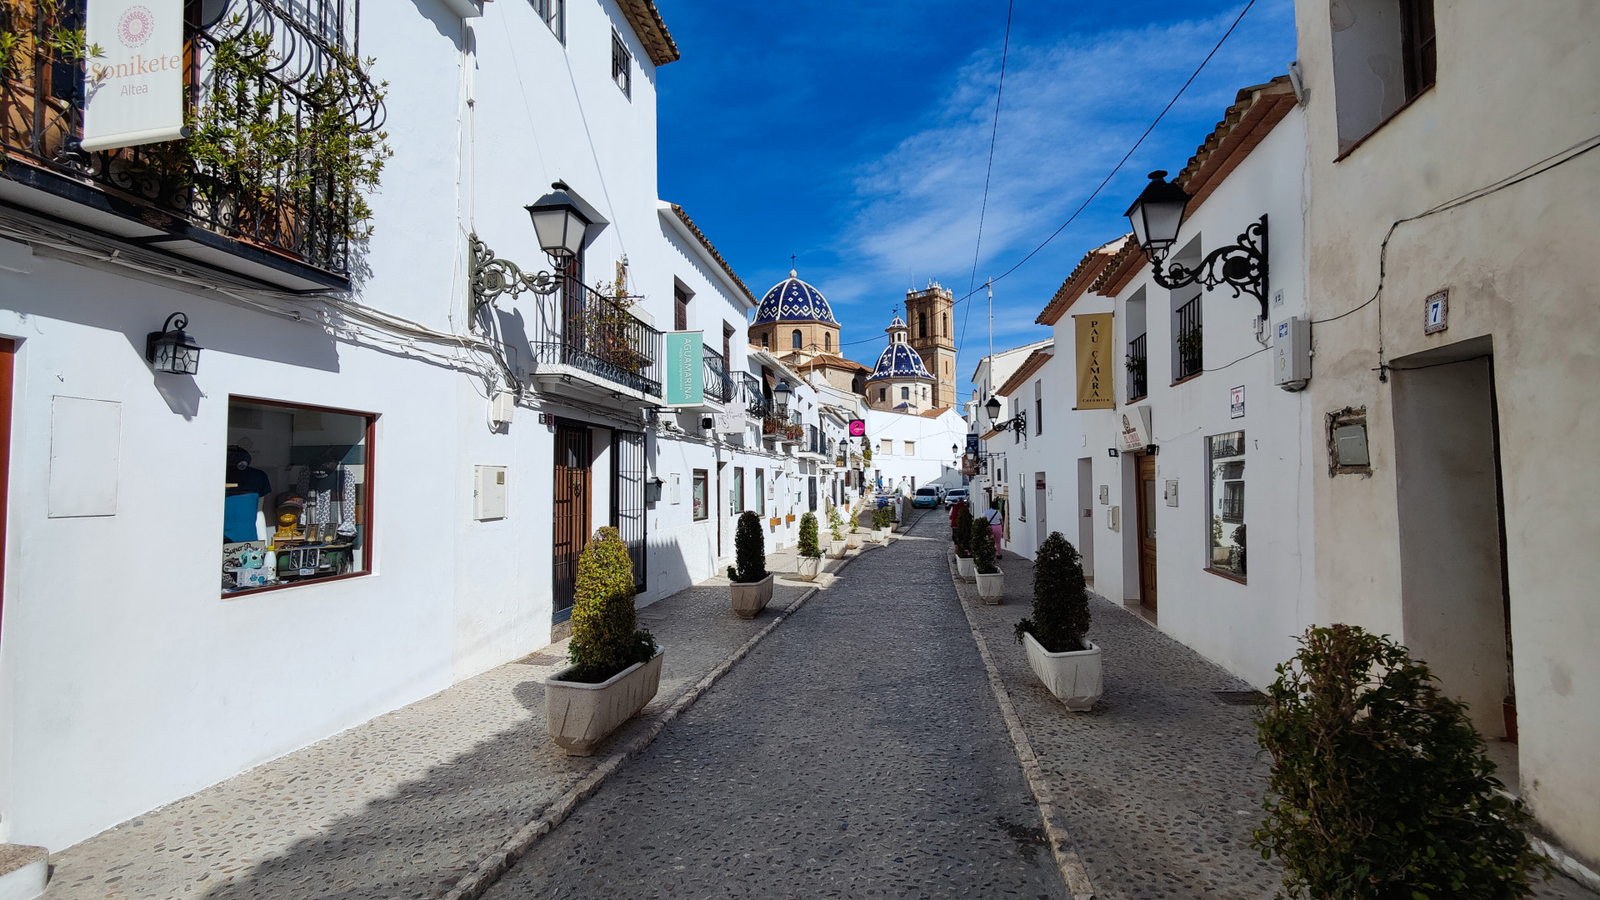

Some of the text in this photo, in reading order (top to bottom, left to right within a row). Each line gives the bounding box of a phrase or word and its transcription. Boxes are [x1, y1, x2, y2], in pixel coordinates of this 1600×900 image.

[91, 54, 181, 82] Sonikete
[120, 84, 149, 97] Altea
[1432, 302, 1439, 323] 7
[1090, 320, 1099, 344] PAU
[683, 337, 692, 400] AGUAMARINA
